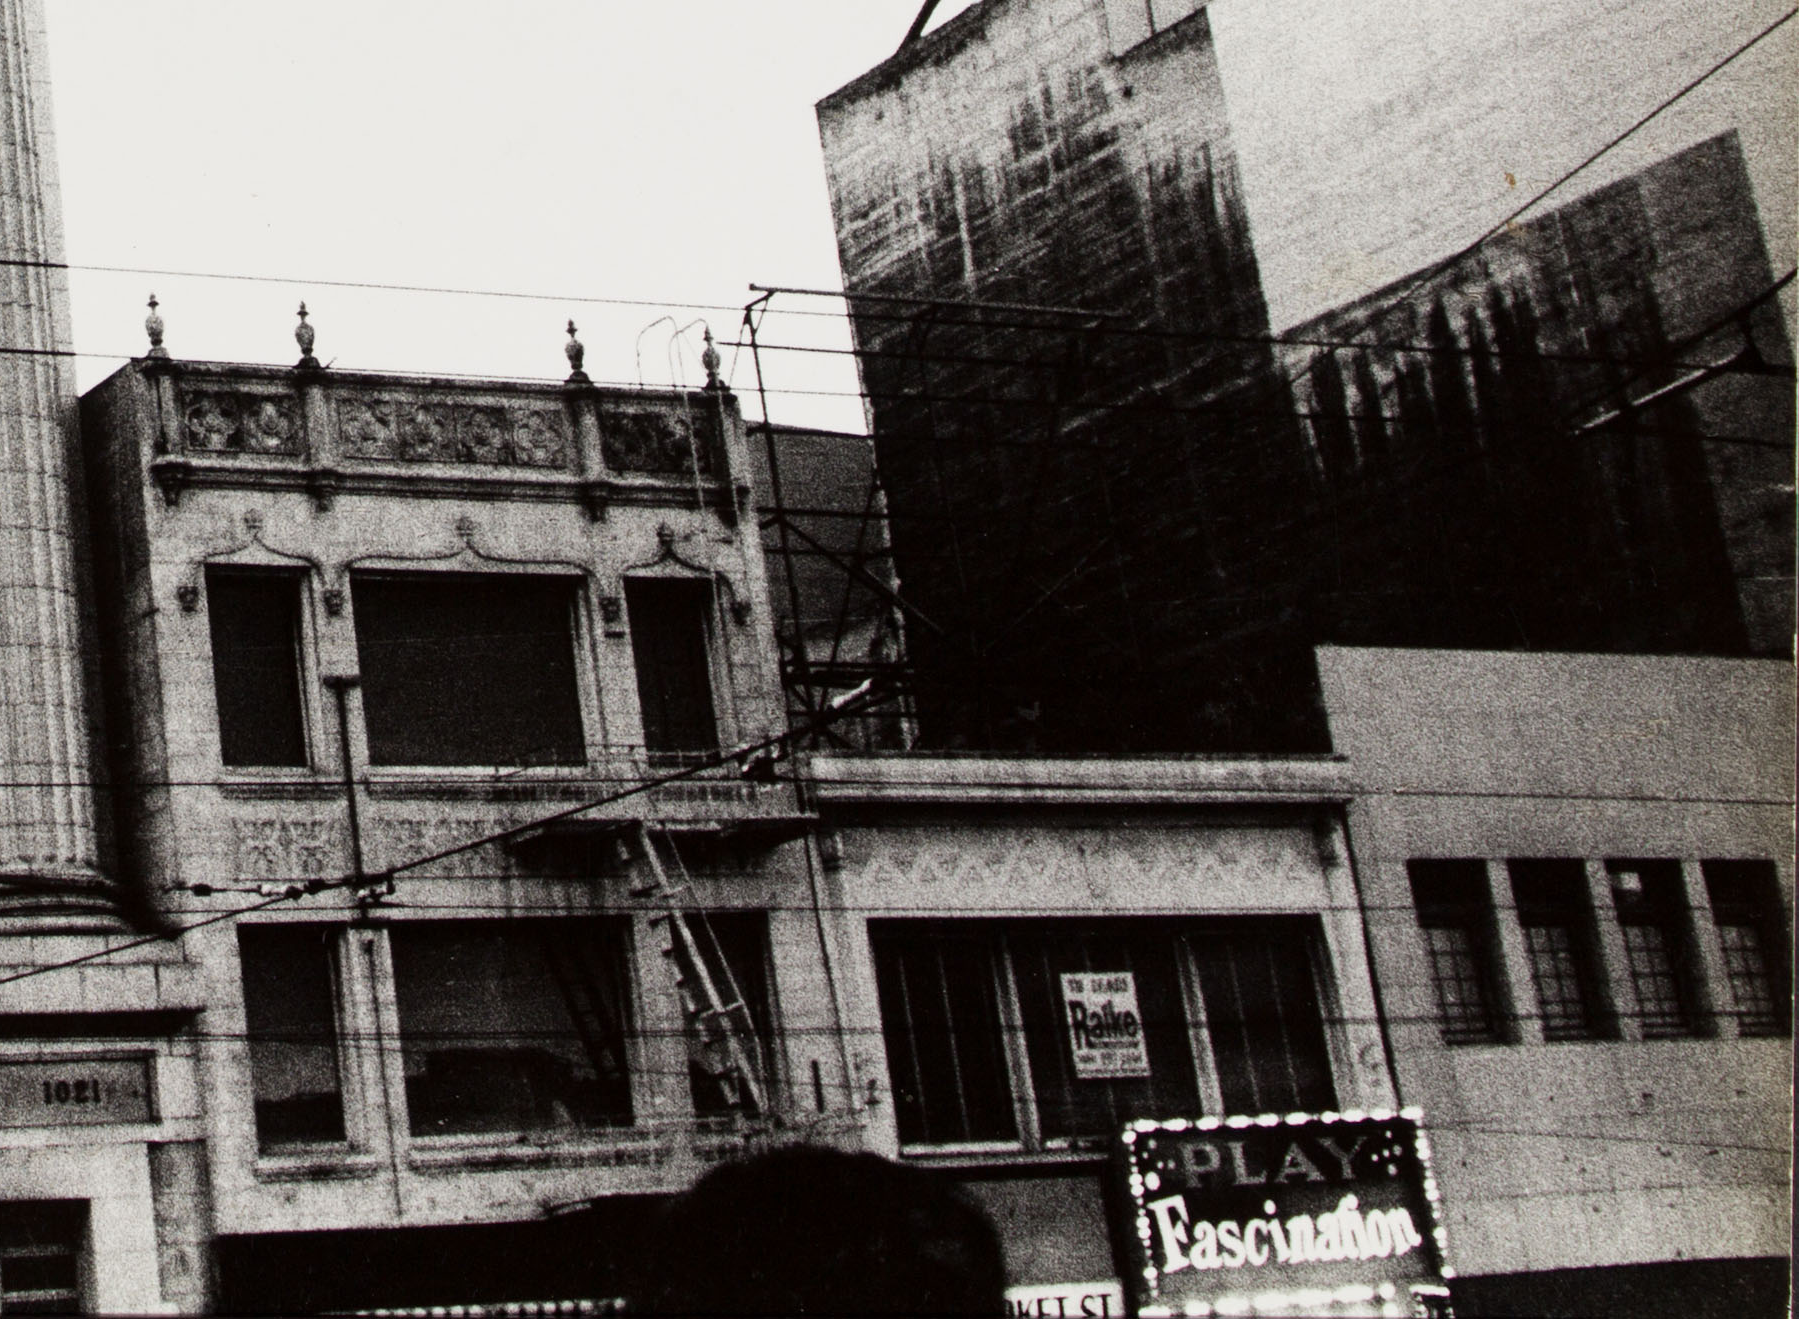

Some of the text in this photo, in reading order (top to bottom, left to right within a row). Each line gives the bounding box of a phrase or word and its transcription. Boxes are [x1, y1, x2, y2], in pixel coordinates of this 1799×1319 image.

[43, 1079, 102, 1105] 1021
[1178, 1136, 1368, 1188] PLAY
[1146, 1193, 1423, 1274] Fascination
